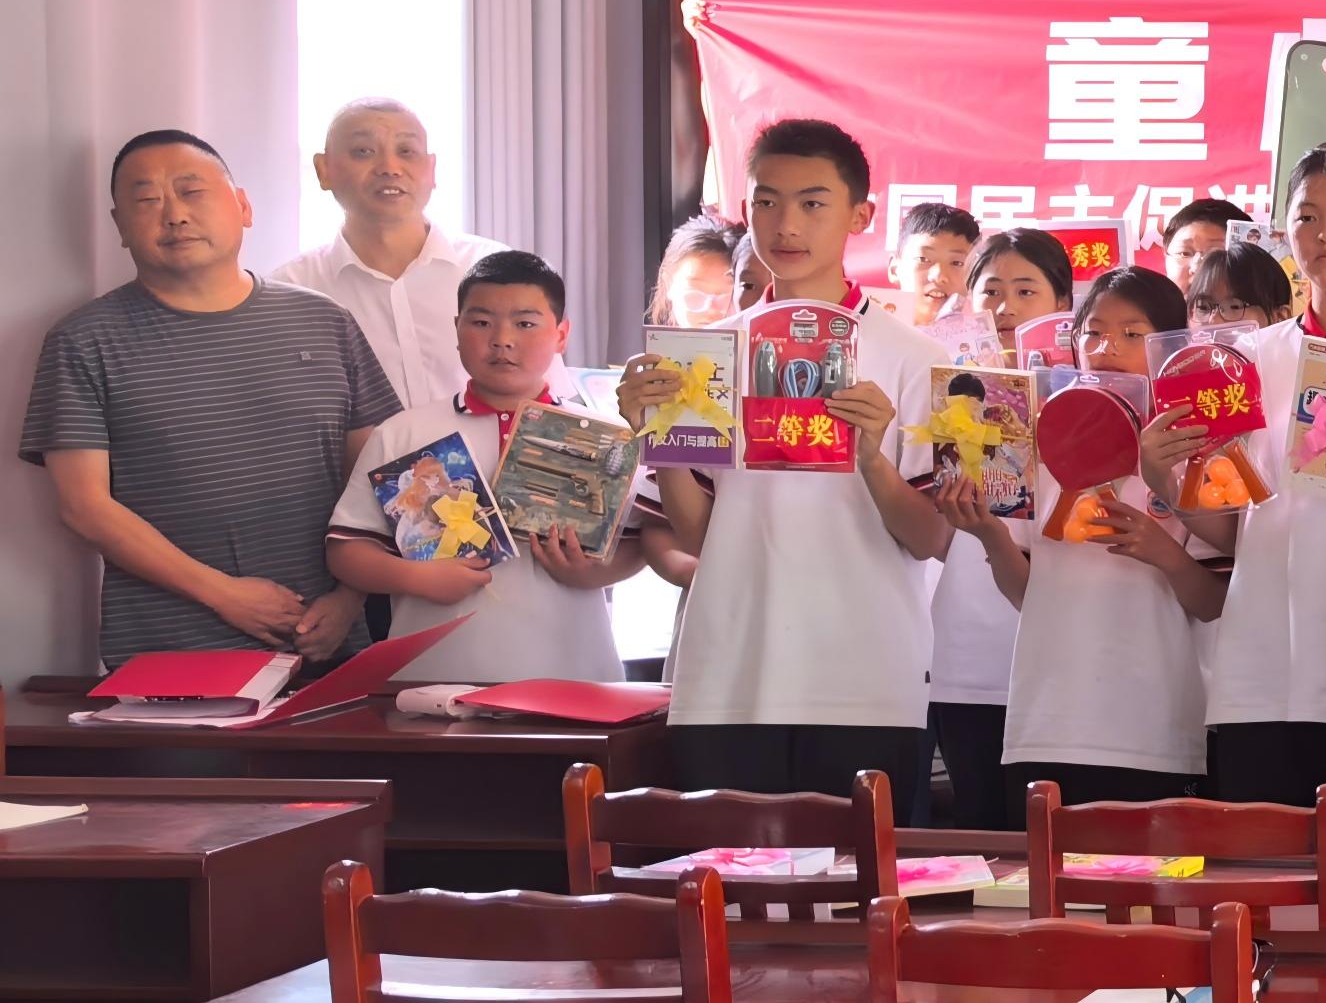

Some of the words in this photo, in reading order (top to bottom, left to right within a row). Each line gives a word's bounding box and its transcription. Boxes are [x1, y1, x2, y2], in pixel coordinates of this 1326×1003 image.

[1064, 242, 1111, 269] 秀奖
[752, 414, 836, 448] 二等奖
